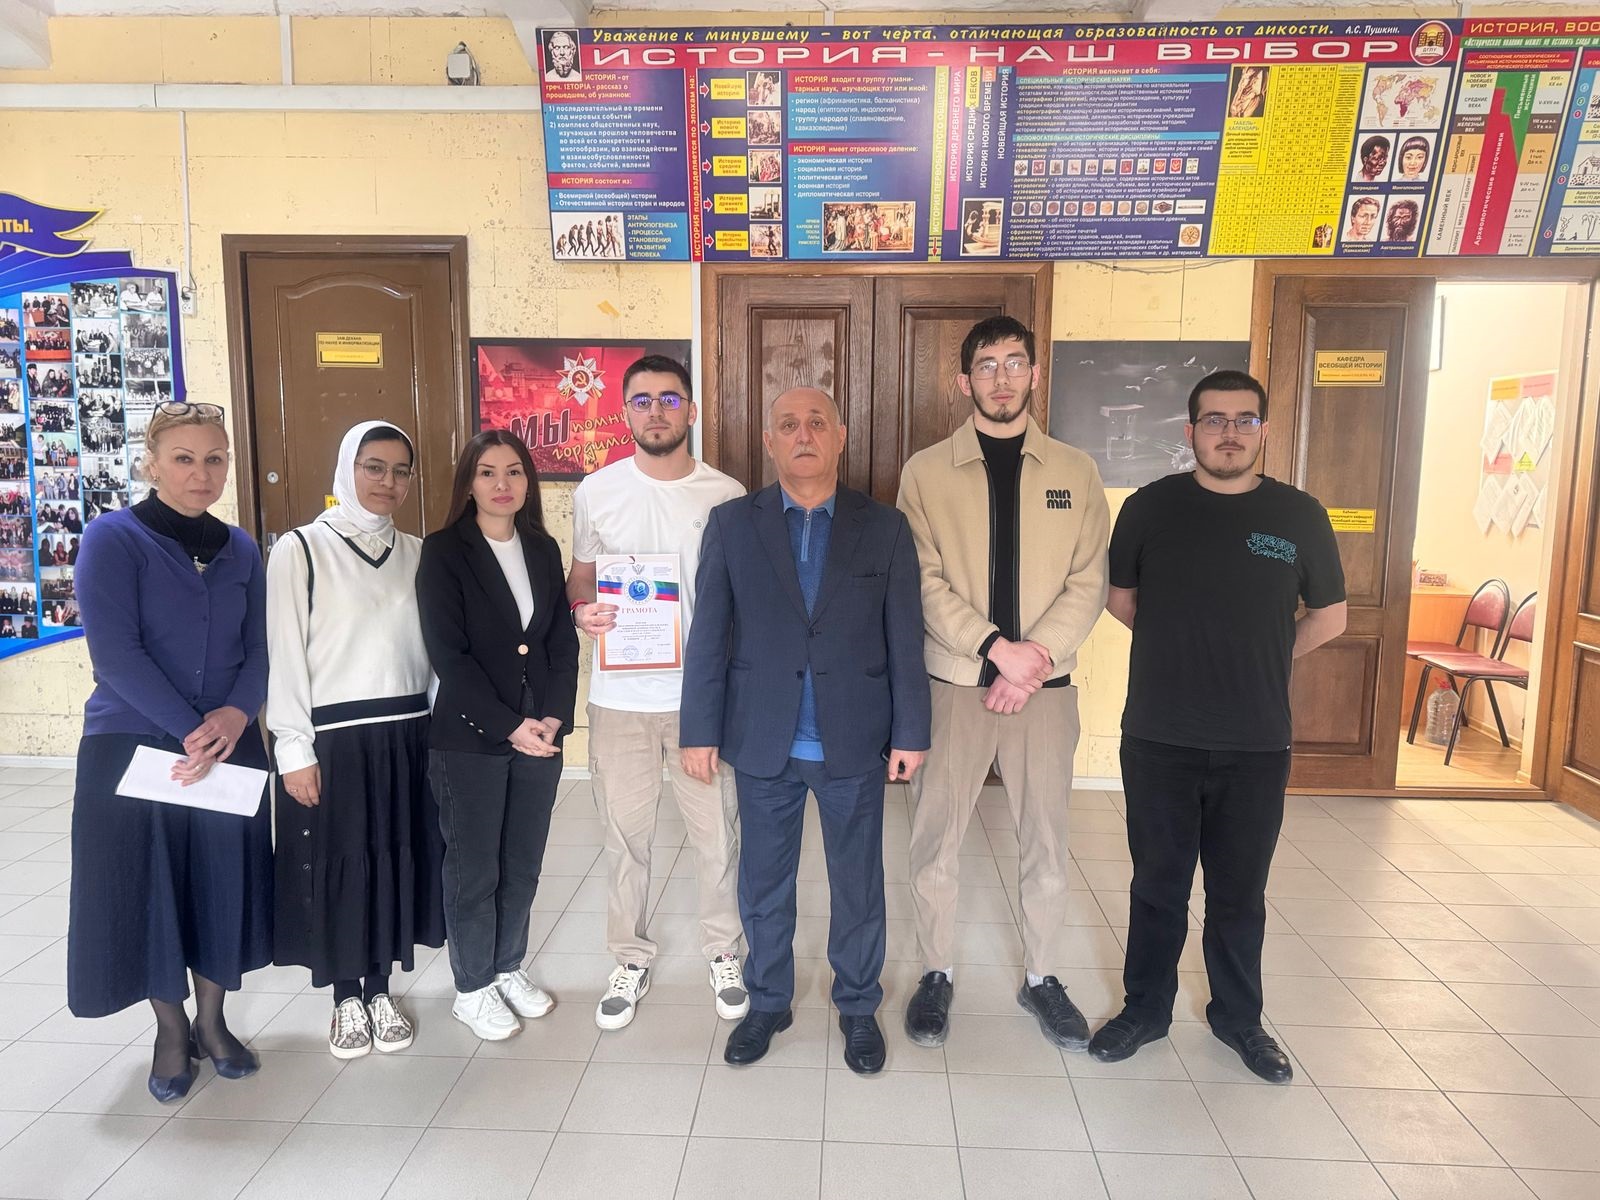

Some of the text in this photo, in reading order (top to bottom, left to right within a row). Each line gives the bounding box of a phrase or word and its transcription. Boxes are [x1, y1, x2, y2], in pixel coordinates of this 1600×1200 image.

[593, 30, 678, 43] Уважение
[685, 32, 694, 41] к
[706, 30, 810, 43] минувшему
[842, 30, 871, 40] вот
[950, 27, 1064, 40] отличающая
[1224, 25, 1244, 36] от
[1254, 24, 1334, 36] дикости.
[1364, 25, 1400, 36] Пушкин.
[1470, 22, 1558, 34] ИСТОРИЯ,
[594, 41, 1399, 65] ИСТОРИЯ НАШ ВЫБОР
[1000, 69, 1009, 108] ИСТОРИЯ
[1514, 74, 1529, 119] Письменные
[1524, 74, 1536, 110] источники
[691, 127, 697, 138] по
[952, 97, 960, 141] ДРЕВНЕГО
[966, 71, 977, 181] ИСТОРИЯ СРЕДНИХ ВЕКОВ
[980, 71, 992, 188] ИСТОРИЯ НОВОГО ВРЕМЕНИ
[933, 194, 941, 232] ИСТОРИЯ
[937, 72, 946, 119] ОБЩЕСТВА
[950, 143, 958, 181] ИСТОРИЯ
[691, 141, 700, 214] подразделяется
[1474, 132, 1504, 245] Археологические источники
[0, 219, 33, 233] ТЫ.
[1436, 204, 1449, 240] КАМЕННЫЙ
[510, 408, 570, 450] МЫ
